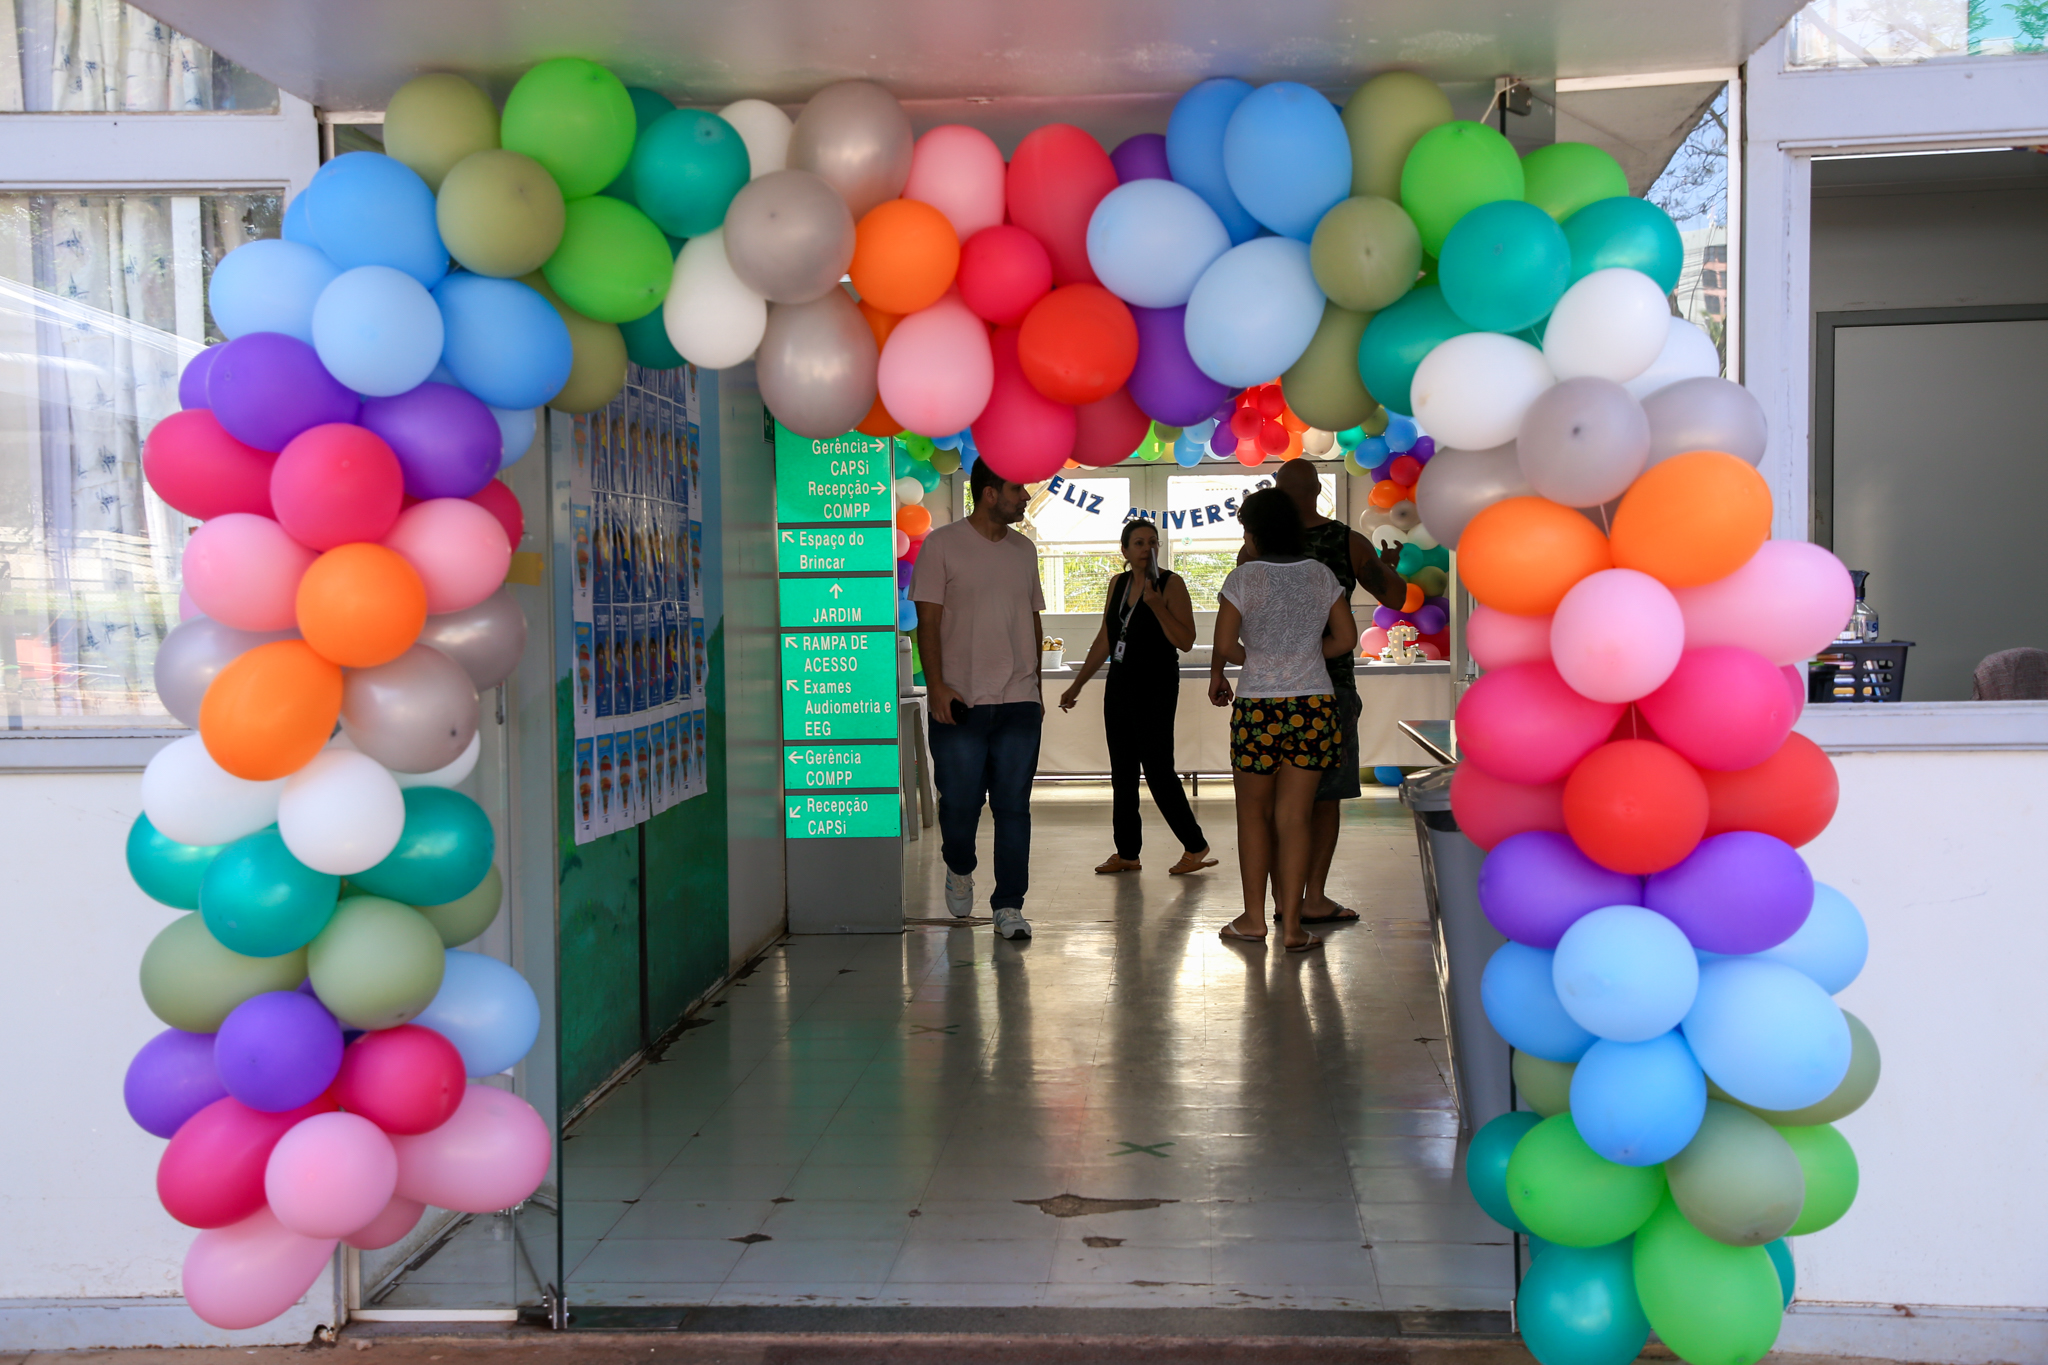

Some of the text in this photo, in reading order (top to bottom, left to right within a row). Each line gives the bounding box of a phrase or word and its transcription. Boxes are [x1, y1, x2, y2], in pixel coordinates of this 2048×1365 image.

[812, 438, 868, 454] Gerência
[831, 460, 869, 476] CAPSi
[809, 480, 869, 498] Recepção
[1047, 474, 1104, 515] ELIZ
[824, 503, 870, 518] COMPP
[800, 531, 864, 549] Espaço do
[800, 555, 845, 569] Brincar
[813, 608, 861, 623] JARDIM
[803, 635, 868, 650] RAMPA DE
[805, 657, 857, 672] ACESSO
[805, 680, 851, 694] Exames
[806, 699, 891, 714] Audiometria e
[806, 721, 831, 736] EEG
[806, 749, 861, 764] Gerência
[806, 771, 852, 786] COMPP
[808, 798, 868, 816] Recepção
[808, 820, 846, 835] CAPSi
